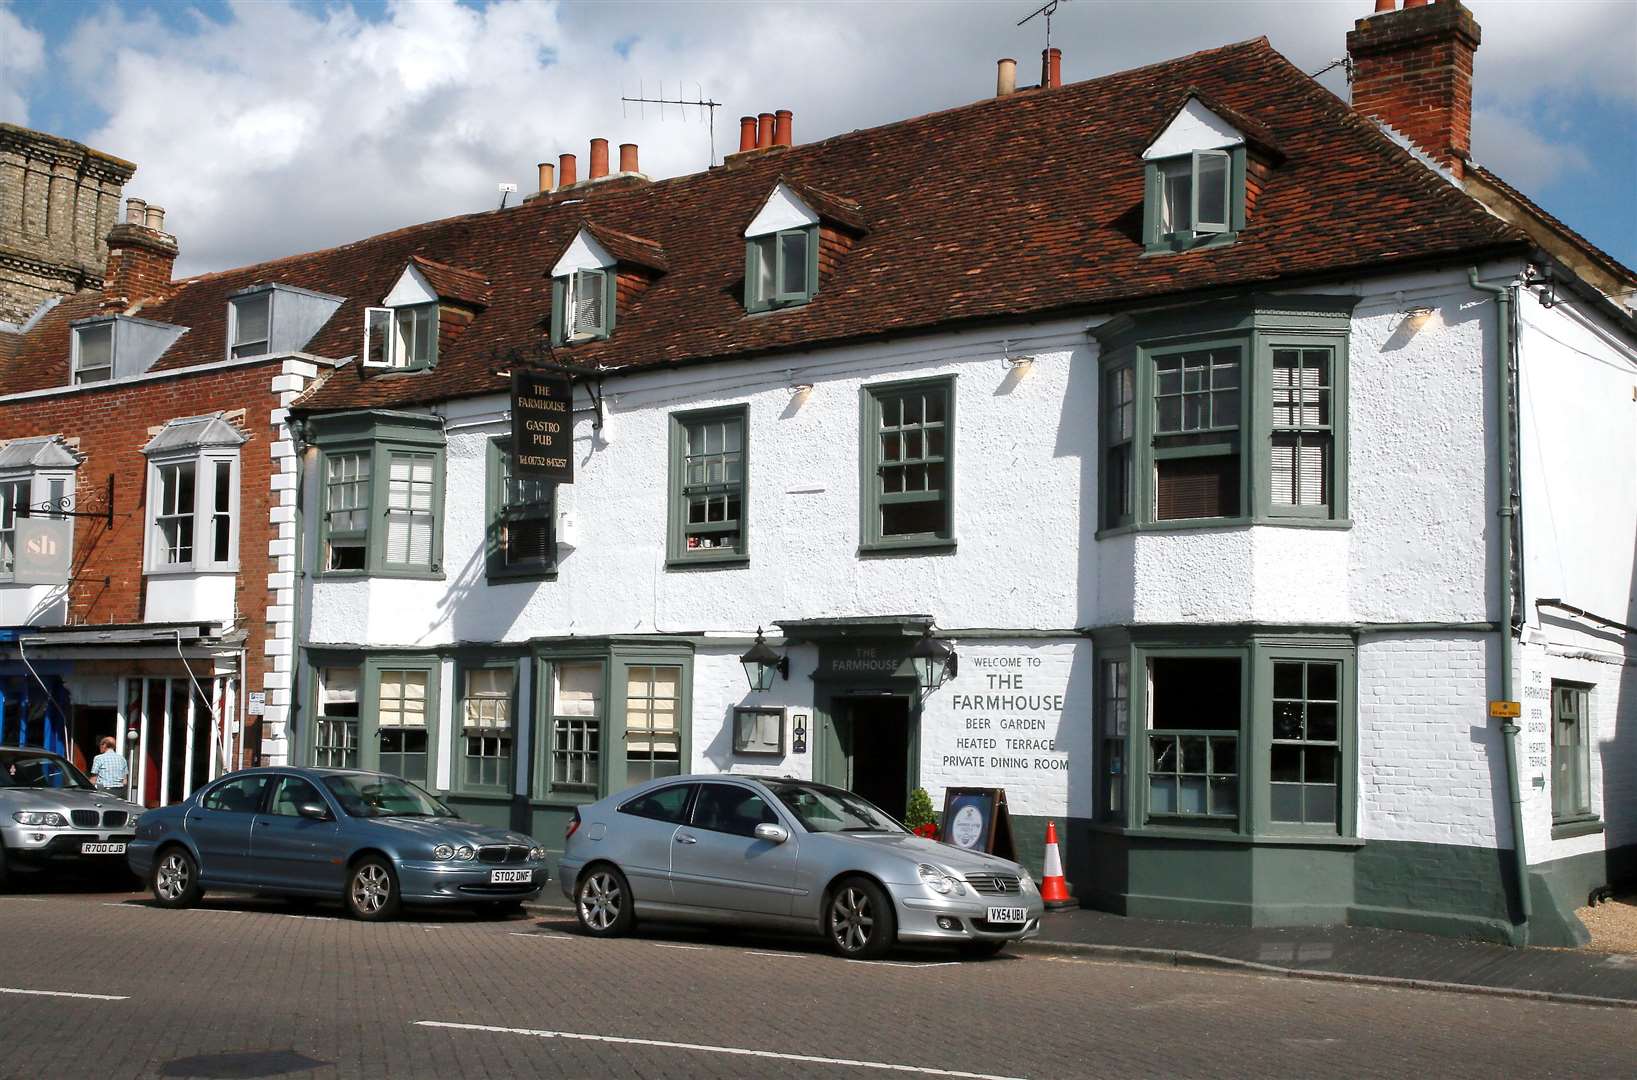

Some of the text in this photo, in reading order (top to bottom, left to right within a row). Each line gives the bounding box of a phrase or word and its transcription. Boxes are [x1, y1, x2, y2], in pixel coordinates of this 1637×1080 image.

[533, 384, 551, 396] THE
[518, 397, 567, 412] FARMHOUSE
[526, 420, 560, 433] GASTRO
[533, 434, 552, 446] PUB
[856, 648, 876, 657] THE
[832, 659, 898, 671] FARMHOUSE
[974, 657, 1041, 667] WELCOME TO
[986, 674, 1023, 689] THE
[952, 695, 1063, 711] FARMHOUSE
[965, 718, 1045, 730] BEER GARDEN
[956, 738, 1055, 750] HEATED TERRACE
[943, 756, 1069, 770] PRIVATE DINING ROOM
[85, 844, 107, 852] R700
[494, 871, 515, 881] ST02
[991, 908, 1010, 920] VX54
